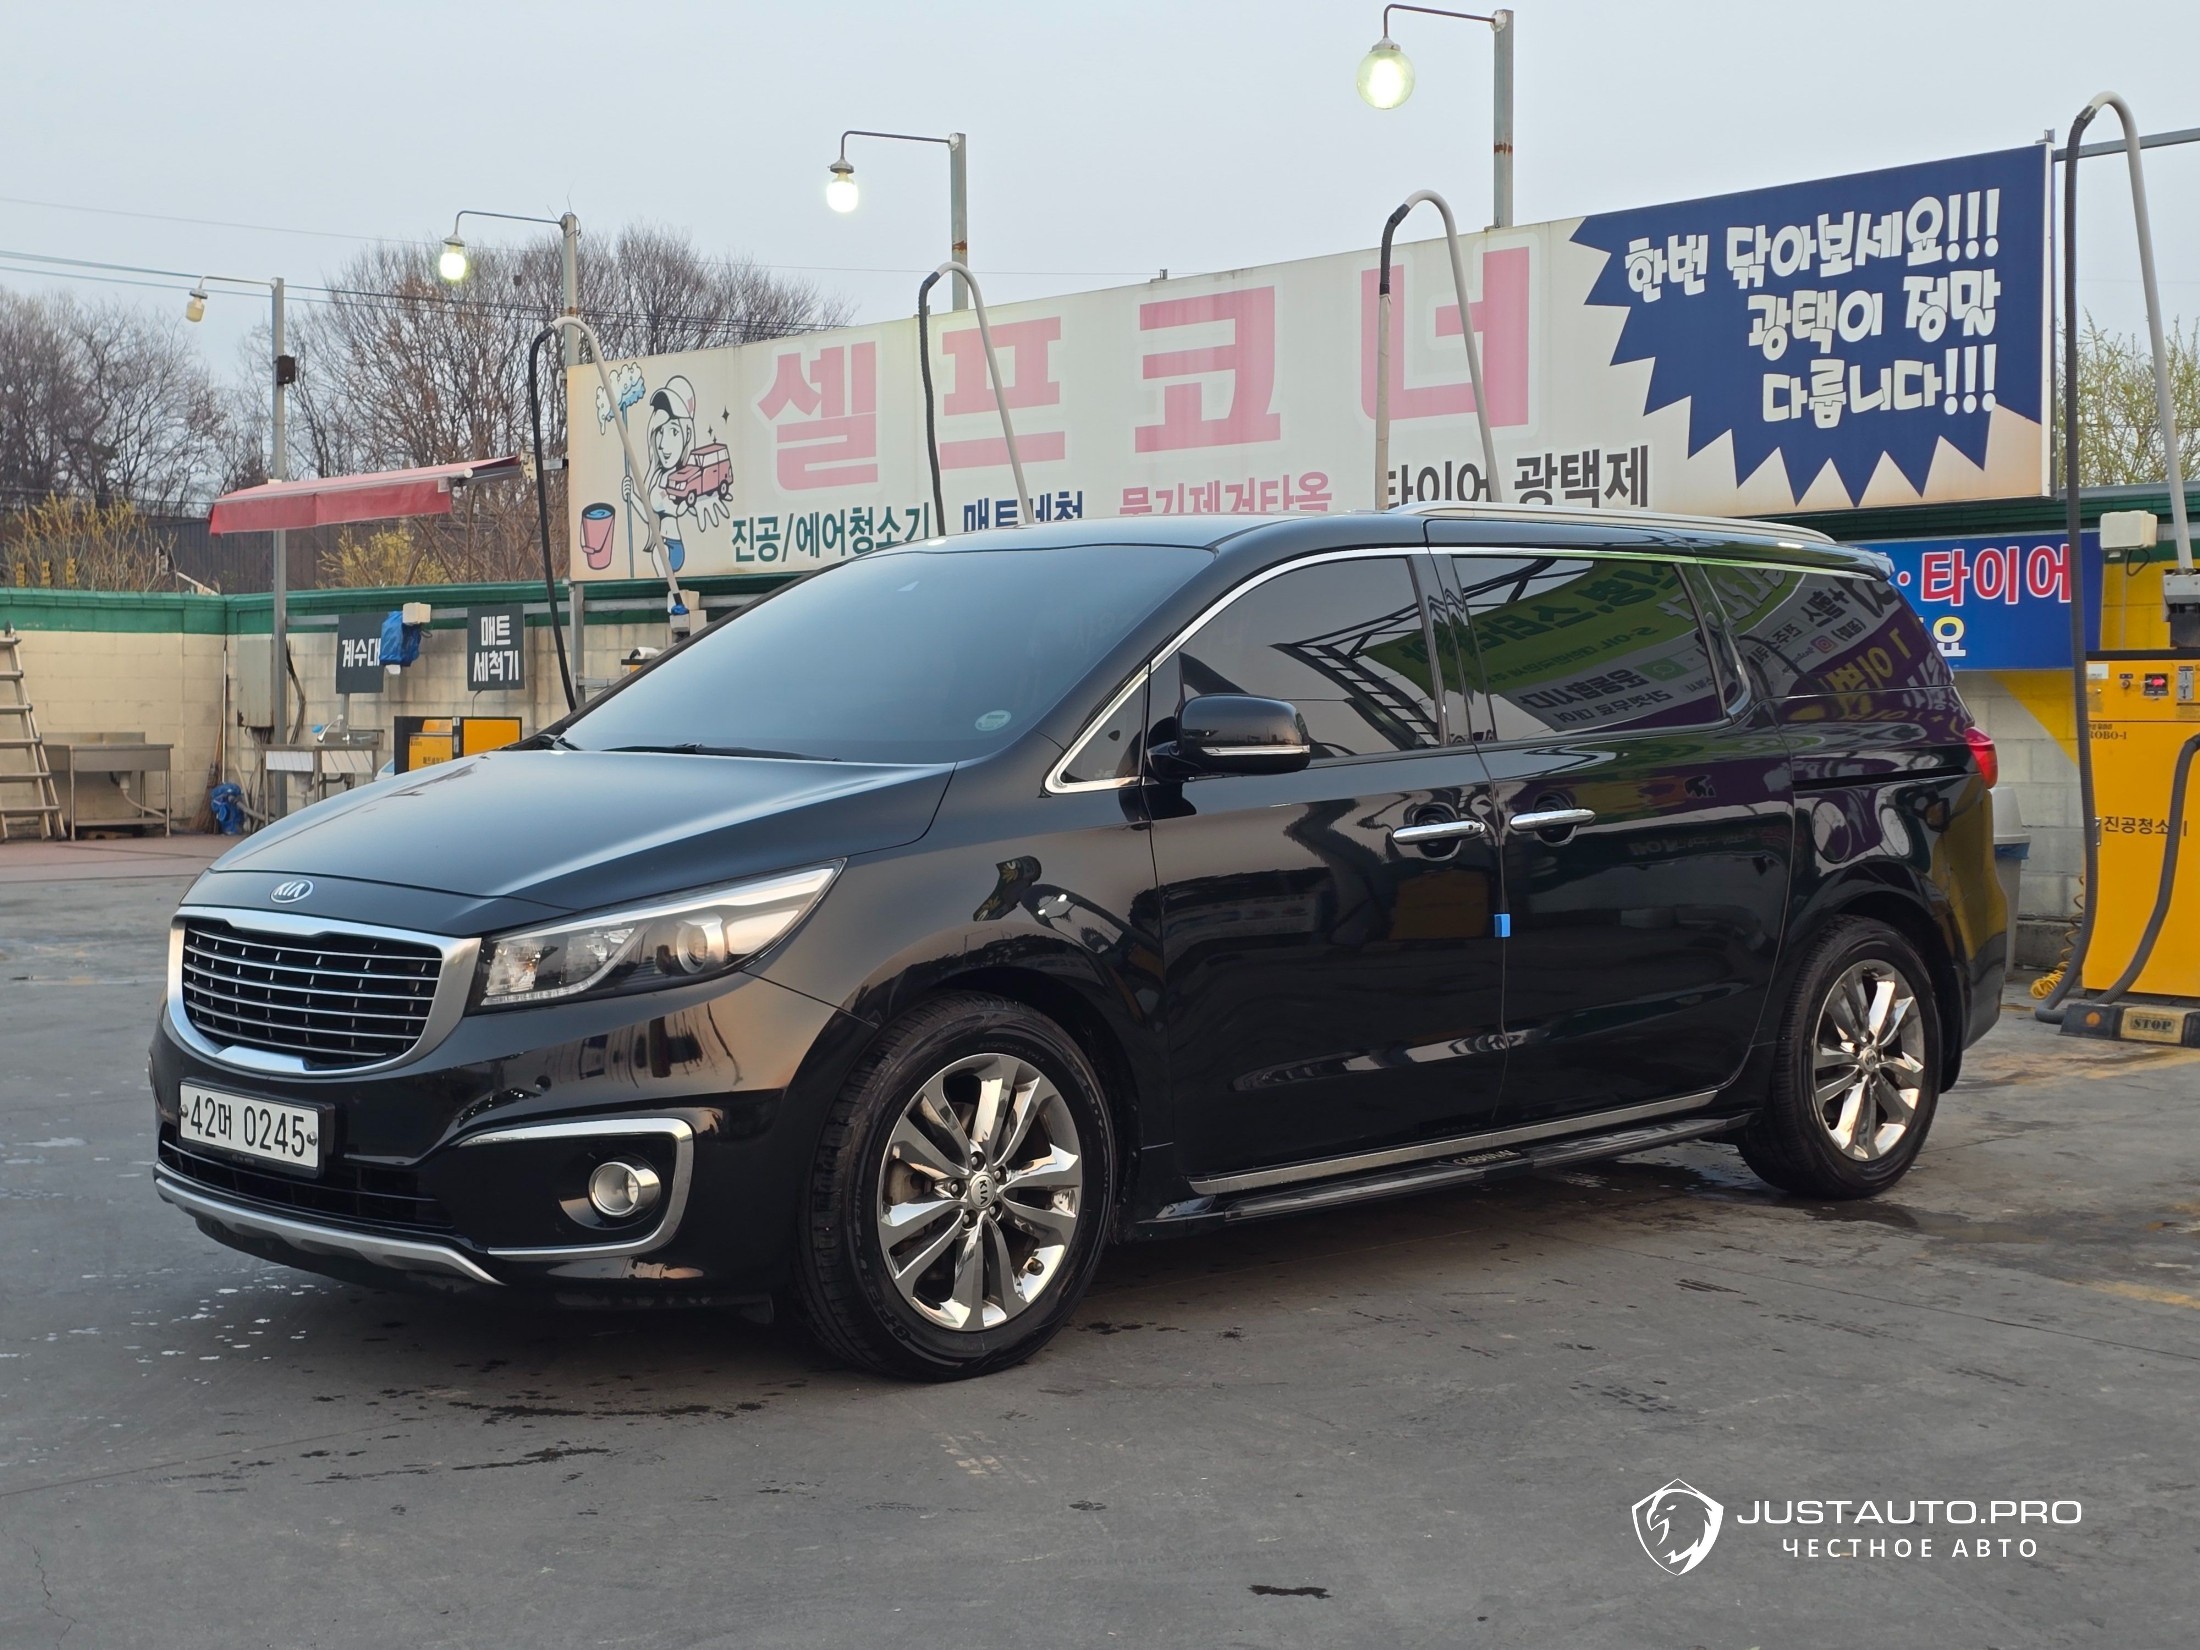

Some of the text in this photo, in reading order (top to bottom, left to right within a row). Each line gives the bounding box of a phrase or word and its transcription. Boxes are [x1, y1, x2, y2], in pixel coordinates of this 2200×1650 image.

[1624, 188, 2000, 303] 한번 닦아보세요!!!
[1747, 268, 2001, 362] 광택이 정말
[1762, 343, 1997, 429] 다릅니다!!!
[1514, 444, 1649, 509] 광택제
[731, 501, 930, 564] 진공/에어청소기
[480, 615, 512, 647] 매트
[473, 649, 520, 683] 세척기
[273, 880, 306, 898] KIA
[2132, 1017, 2173, 1032] STOP
[190, 1094, 306, 1158] 42머 0245
[979, 1179, 988, 1206] KIA
